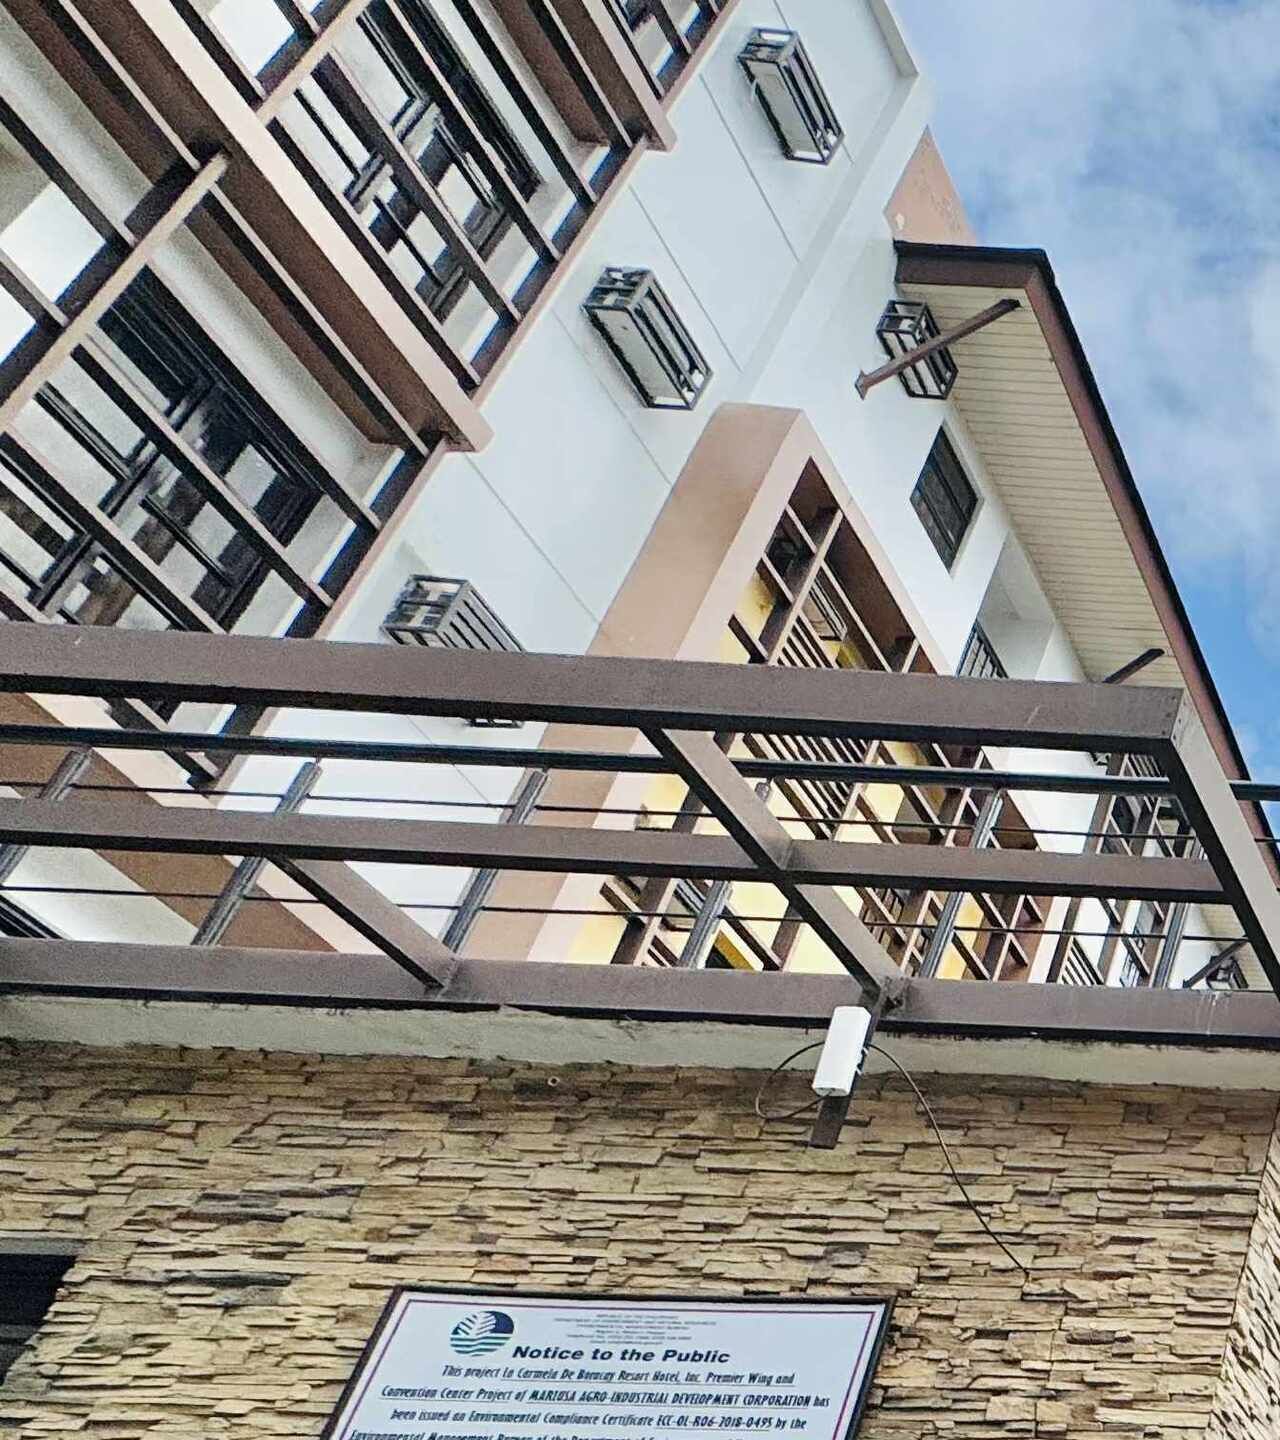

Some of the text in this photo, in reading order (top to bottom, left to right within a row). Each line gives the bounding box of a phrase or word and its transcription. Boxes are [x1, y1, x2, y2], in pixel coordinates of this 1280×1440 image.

[512, 1345, 730, 1363] Notice to the Public
[442, 1364, 462, 1377] This
[463, 1366, 501, 1378] project
[503, 1367, 515, 1378] La
[517, 1368, 558, 1380] Carmela
[560, 1369, 575, 1380] De
[577, 1369, 616, 1382] Boracay
[618, 1370, 650, 1381] Resort
[705, 1372, 745, 1384] Premier
[748, 1373, 774, 1387] Wing
[775, 1373, 795, 1384] and
[381, 1385, 437, 1398] Convention
[440, 1387, 474, 1399] Center
[476, 1388, 513, 1402] Project
[514, 1389, 528, 1401] of
[671, 1393, 741, 1406] DEVELOPMENT
[743, 1394, 811, 1407] CORPORATION
[812, 1396, 830, 1408] has
[390, 1409, 416, 1420] been
[418, 1410, 451, 1421] issued
[452, 1412, 466, 1422] an
[468, 1411, 541, 1423] Environmental
[543, 1412, 599, 1425] Compliance
[602, 1414, 654, 1426] Certificate
[775, 1418, 788, 1430] by
[790, 1419, 807, 1429] the
